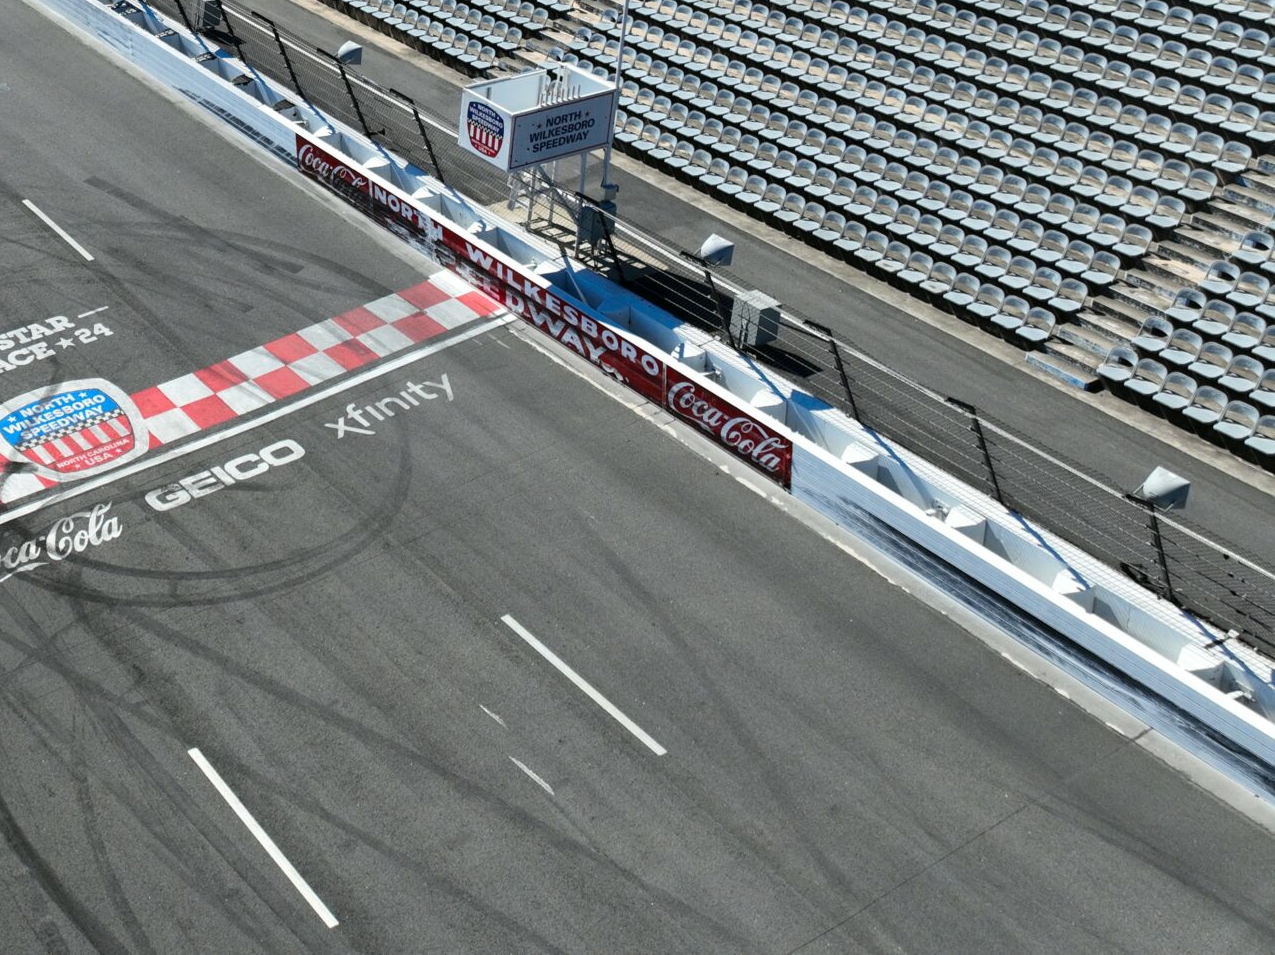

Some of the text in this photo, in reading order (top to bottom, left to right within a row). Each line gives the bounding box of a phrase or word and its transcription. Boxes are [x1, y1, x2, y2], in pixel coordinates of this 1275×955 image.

[477, 103, 496, 118] NORTH
[546, 111, 582, 127] NORTH
[529, 118, 596, 143] WILKESBORO
[532, 130, 590, 153] SPEEDWAY
[465, 243, 659, 377] WILKESBORO
[75, 323, 114, 344] 24
[3, 394, 106, 435] WILKESBORO
[19, 393, 76, 418] NORTH
[325, 373, 455, 440] xfinity
[20, 405, 104, 440] SPEEDWAY
[668, 382, 789, 473] Coca-Cola
[56, 438, 130, 469] NORTH CAROLINA
[85, 453, 114, 466] USA
[145, 438, 306, 511] GEICO
